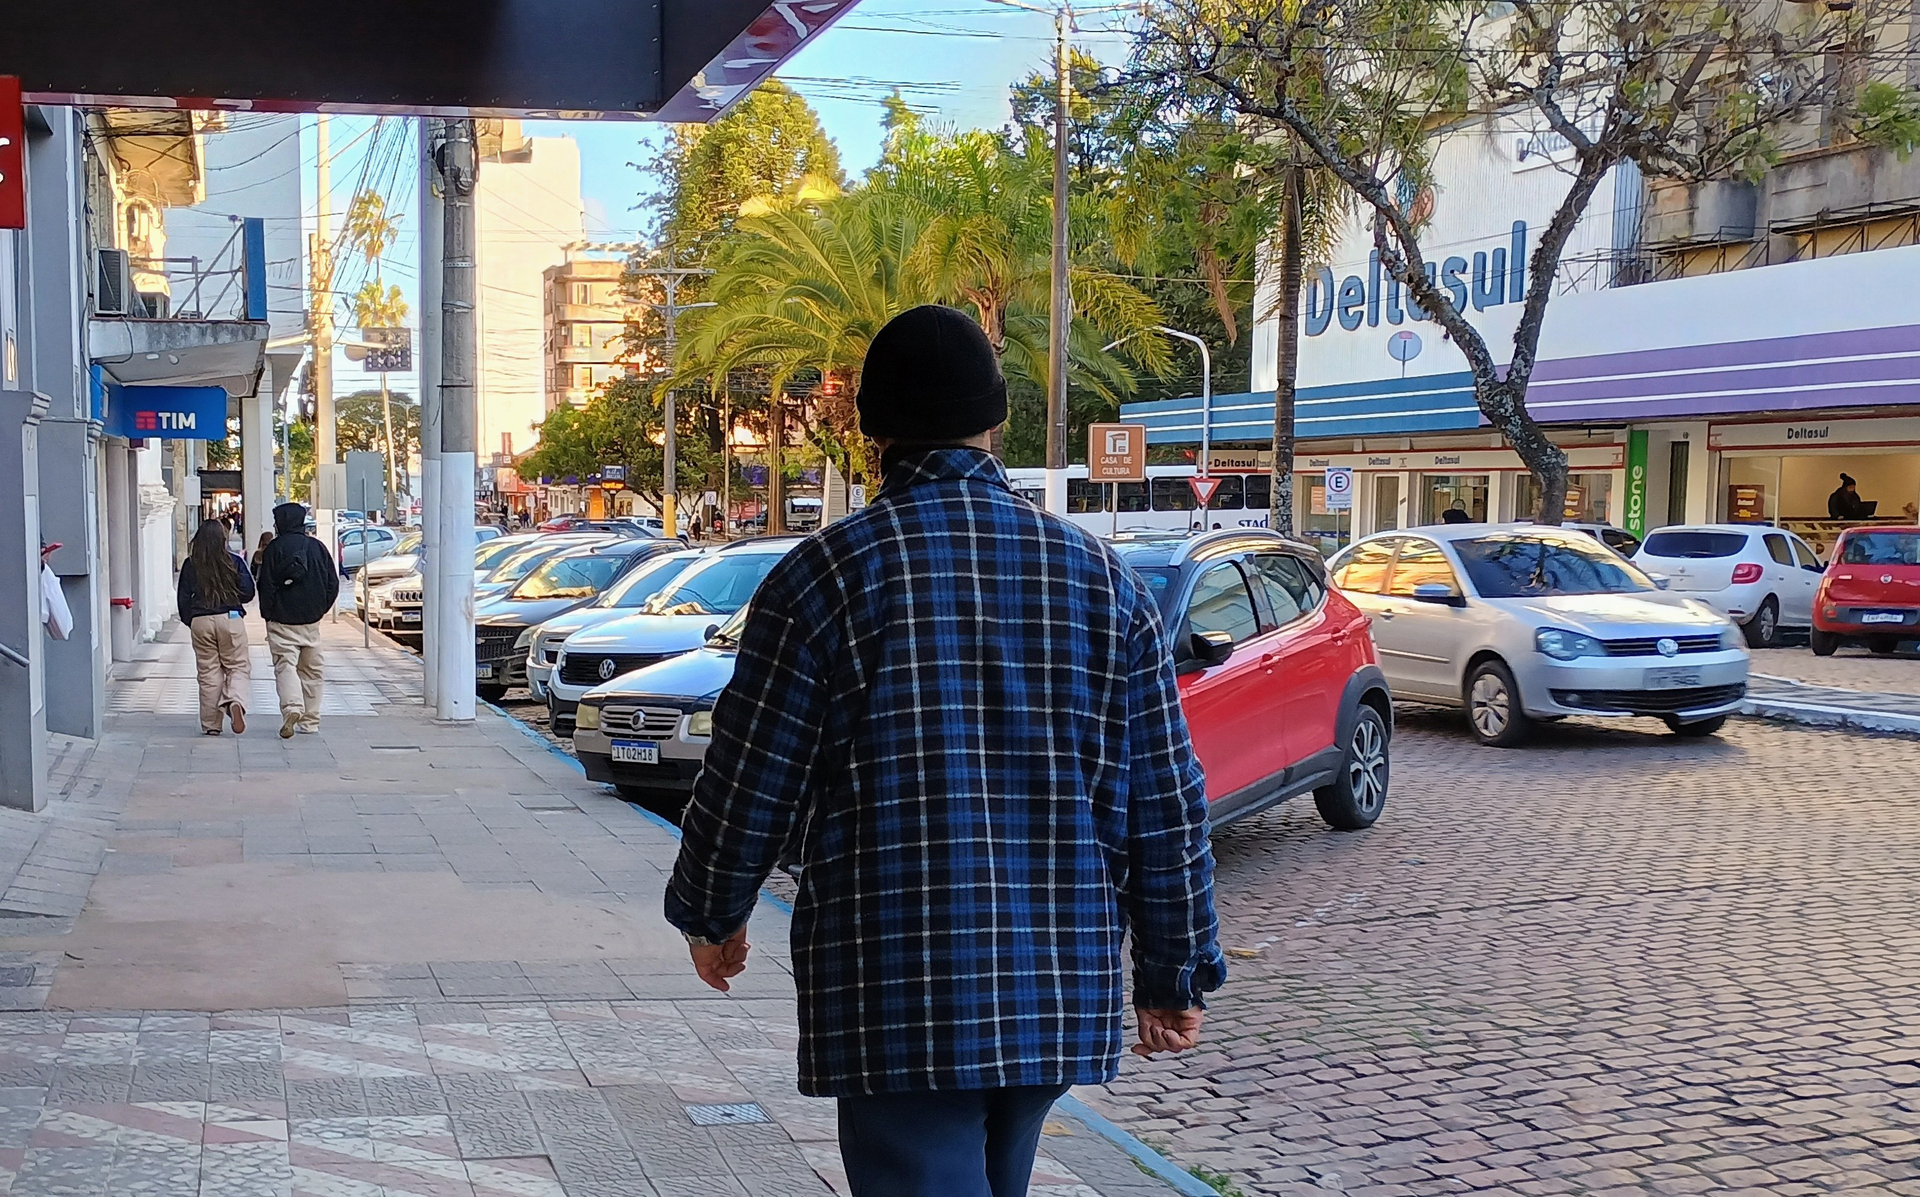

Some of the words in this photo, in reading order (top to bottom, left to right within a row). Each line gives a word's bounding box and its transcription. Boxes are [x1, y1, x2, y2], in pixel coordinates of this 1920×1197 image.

[1305, 220, 1527, 337] Deltasul
[158, 412, 196, 430] TIM
[1787, 426, 1829, 439] Deltasul
[1100, 456, 1118, 465] CASA
[1123, 456, 1133, 464] DE
[1214, 458, 1256, 467] Deltasul
[1101, 467, 1131, 475] CULTURA
[1335, 476, 1343, 488] E
[1628, 465, 1643, 531] stone
